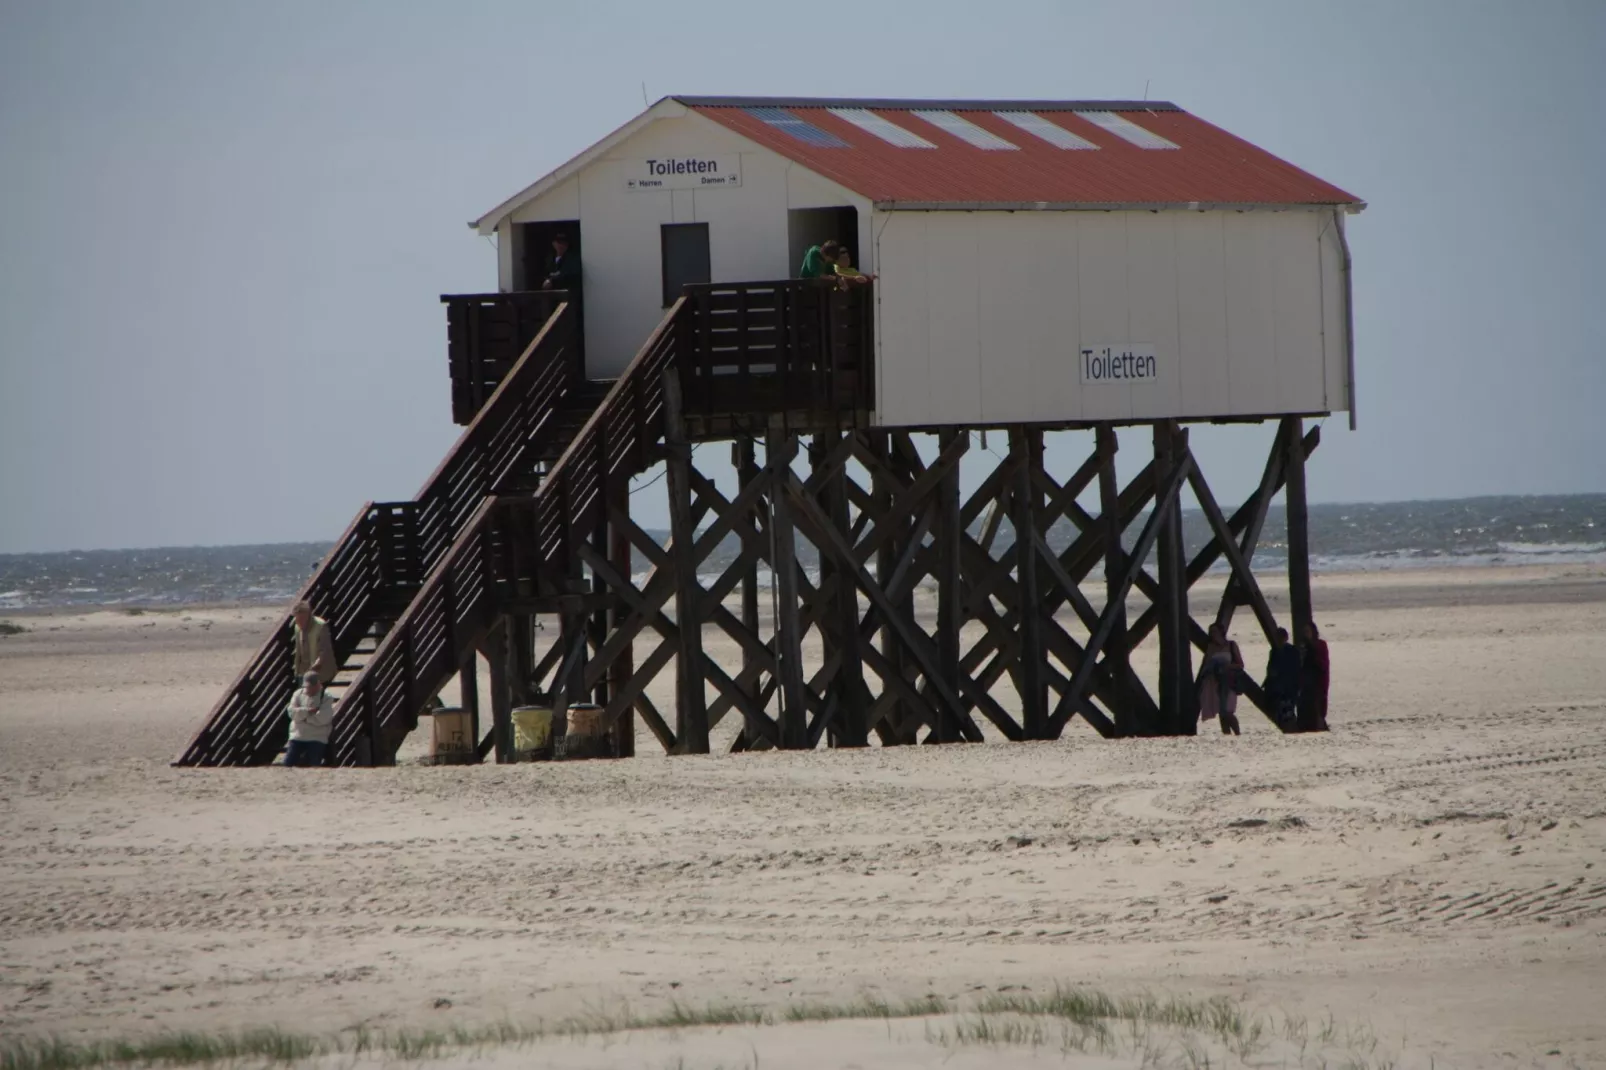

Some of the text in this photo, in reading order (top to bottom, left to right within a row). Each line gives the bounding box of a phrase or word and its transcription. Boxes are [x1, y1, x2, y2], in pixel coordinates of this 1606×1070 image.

[646, 159, 718, 175] Toiletten
[639, 179, 662, 188] Herren
[701, 176, 725, 185] Damen
[1081, 347, 1156, 379] Toiletten
